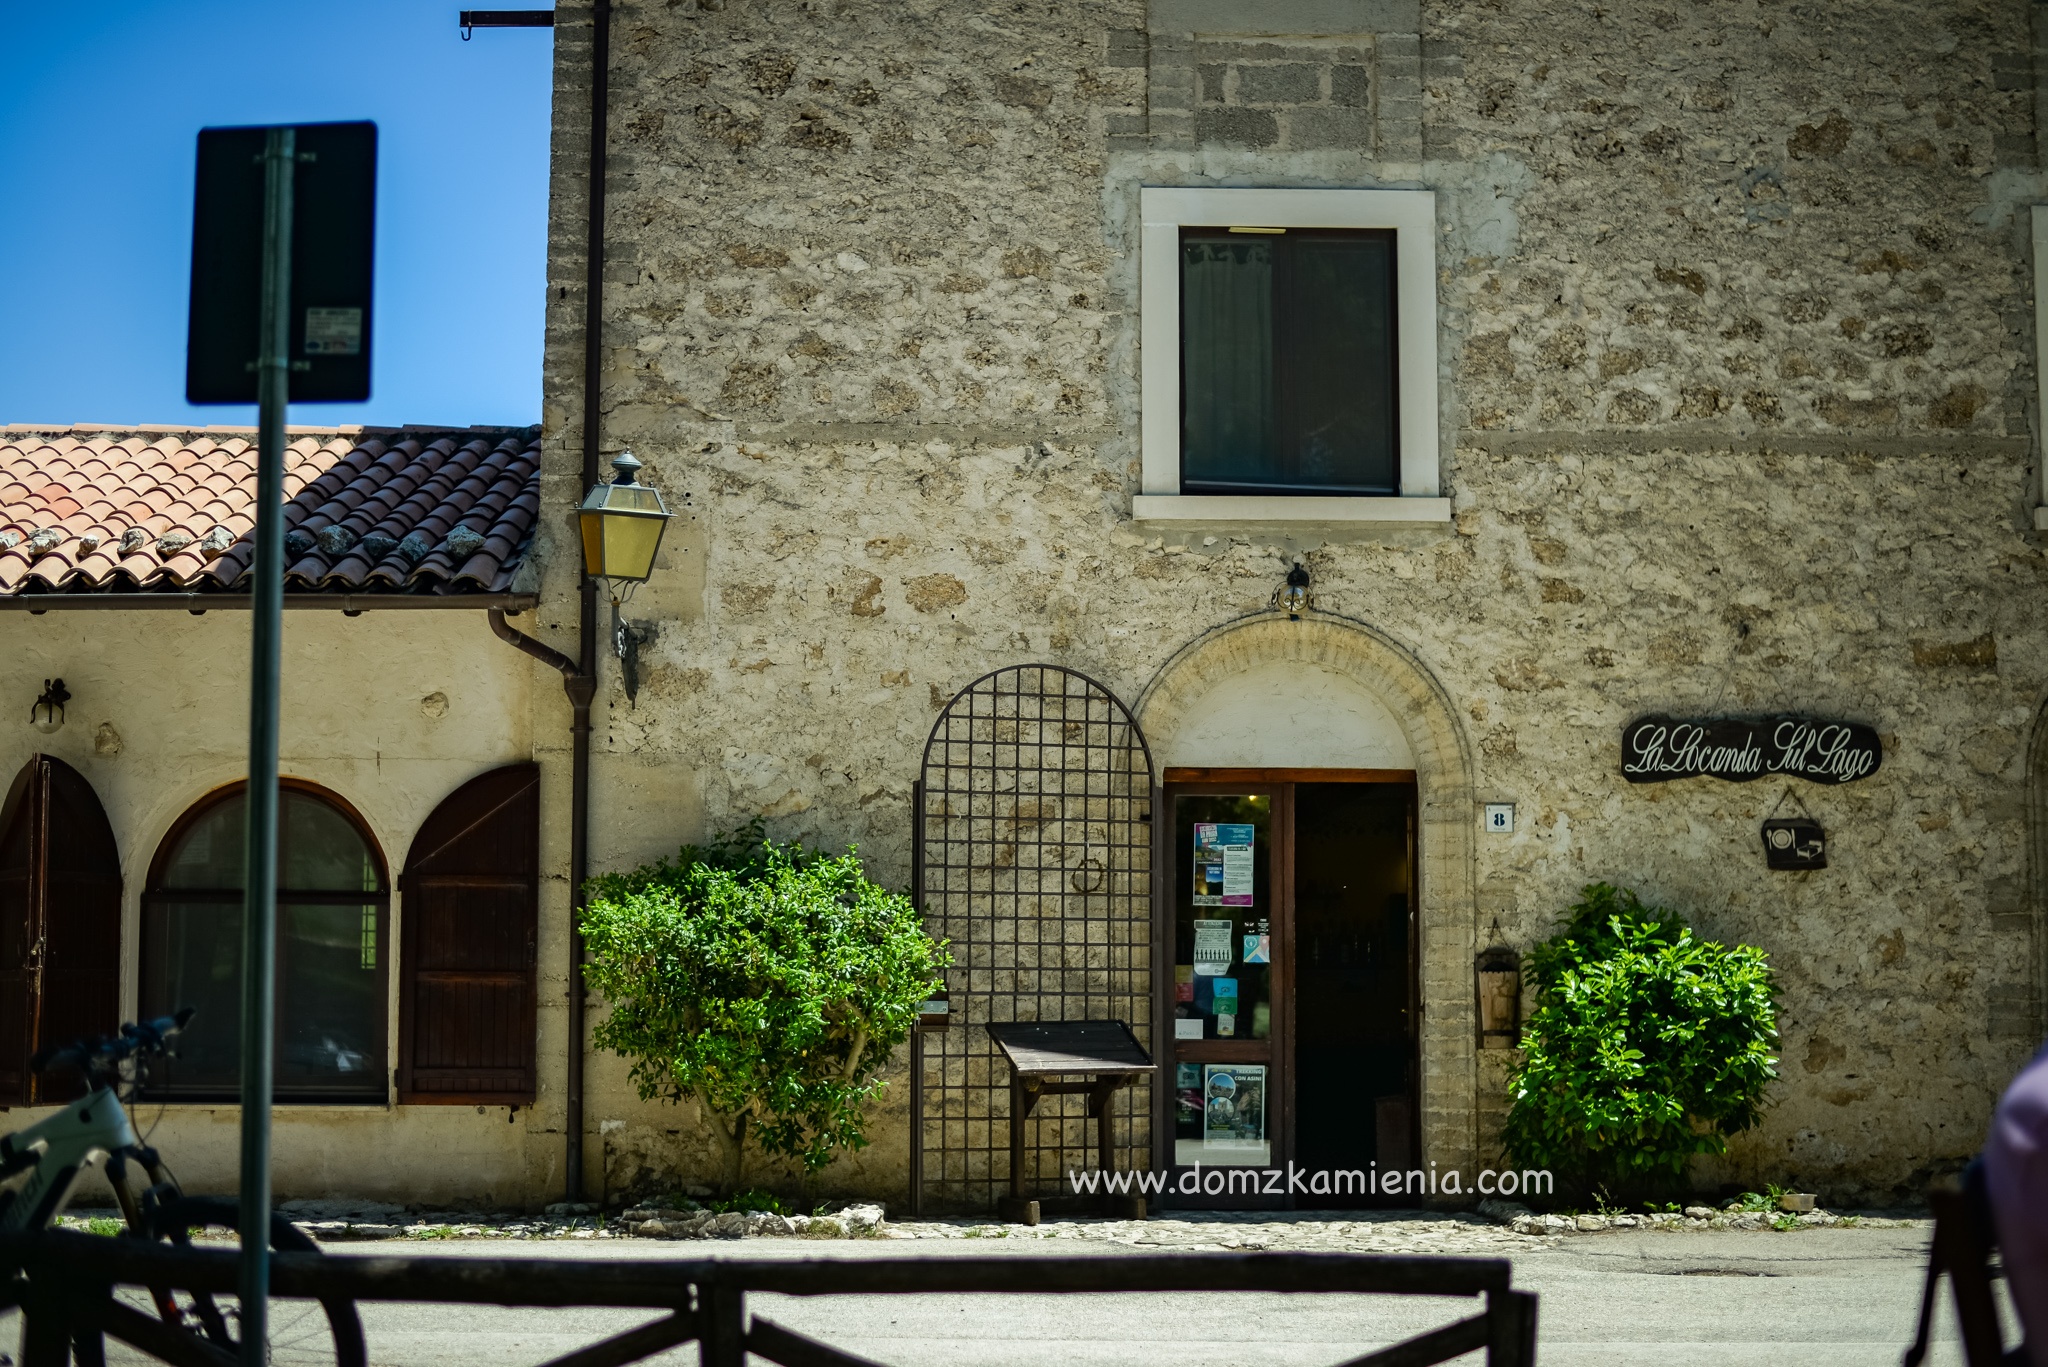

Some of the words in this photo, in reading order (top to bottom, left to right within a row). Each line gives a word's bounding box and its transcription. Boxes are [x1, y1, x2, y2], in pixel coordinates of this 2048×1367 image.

[1625, 724, 1666, 772] La
[1661, 723, 1762, 773] Locanda
[1767, 721, 1816, 773] Sul
[1807, 724, 1874, 782] Lago
